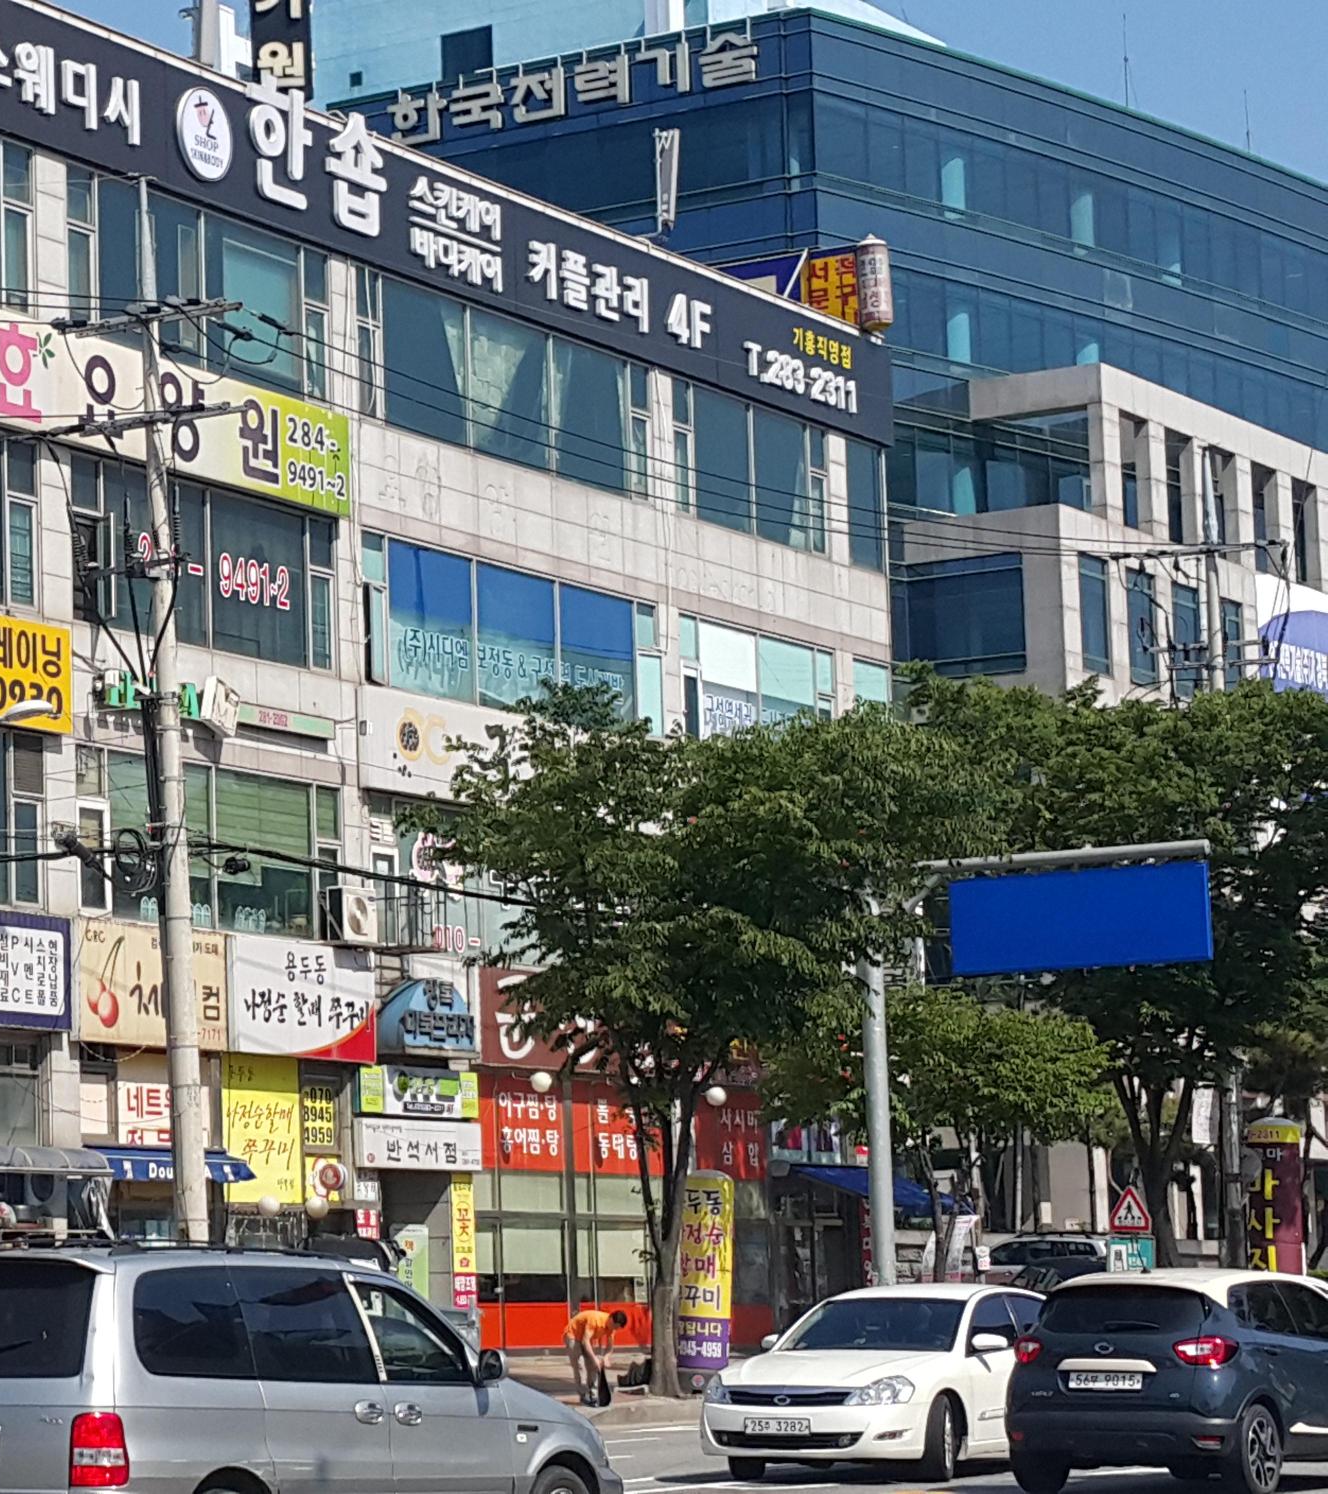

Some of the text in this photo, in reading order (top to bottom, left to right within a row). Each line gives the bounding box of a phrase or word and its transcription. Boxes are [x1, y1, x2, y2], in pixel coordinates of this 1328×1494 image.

[386, 31, 759, 146] 한국전력기술
[193, 134, 219, 152] SHOP
[408, 176, 502, 241] 스킨케어
[409, 226, 504, 293] 바디케어
[527, 239, 712, 349] 커플관리 4F
[792, 327, 853, 370] 기흥직영점
[743, 341, 858, 414] T.283-2311
[517, 654, 527, 678] &
[284, 951, 327, 985] 용두동
[309, 1087, 332, 1103] 070
[303, 1105, 333, 1123] 8945
[303, 1126, 333, 1144] 4959
[386, 1139, 458, 1165] 반석서점
[1104, 1374, 1136, 1387] 9015
